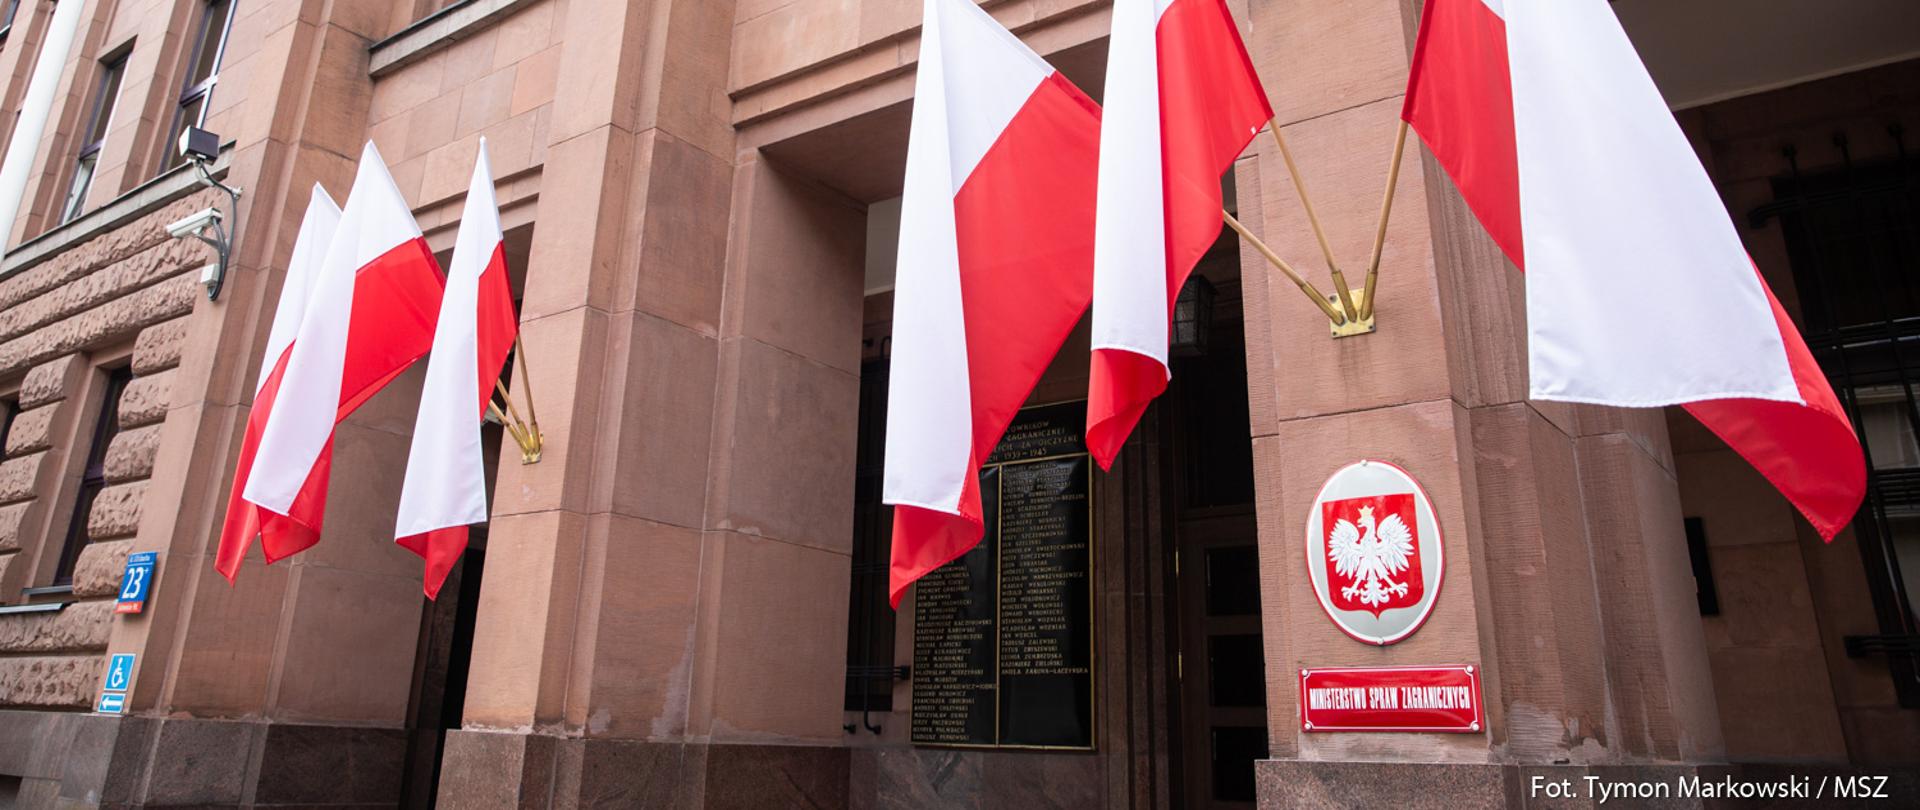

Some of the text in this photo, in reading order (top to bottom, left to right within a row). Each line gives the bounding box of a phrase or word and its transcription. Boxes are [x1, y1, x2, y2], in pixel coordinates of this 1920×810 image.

[122, 566, 144, 599] 23
[1309, 686, 1471, 710] MINISTERSTWO SPRAW ZAGRANICZNYCH
